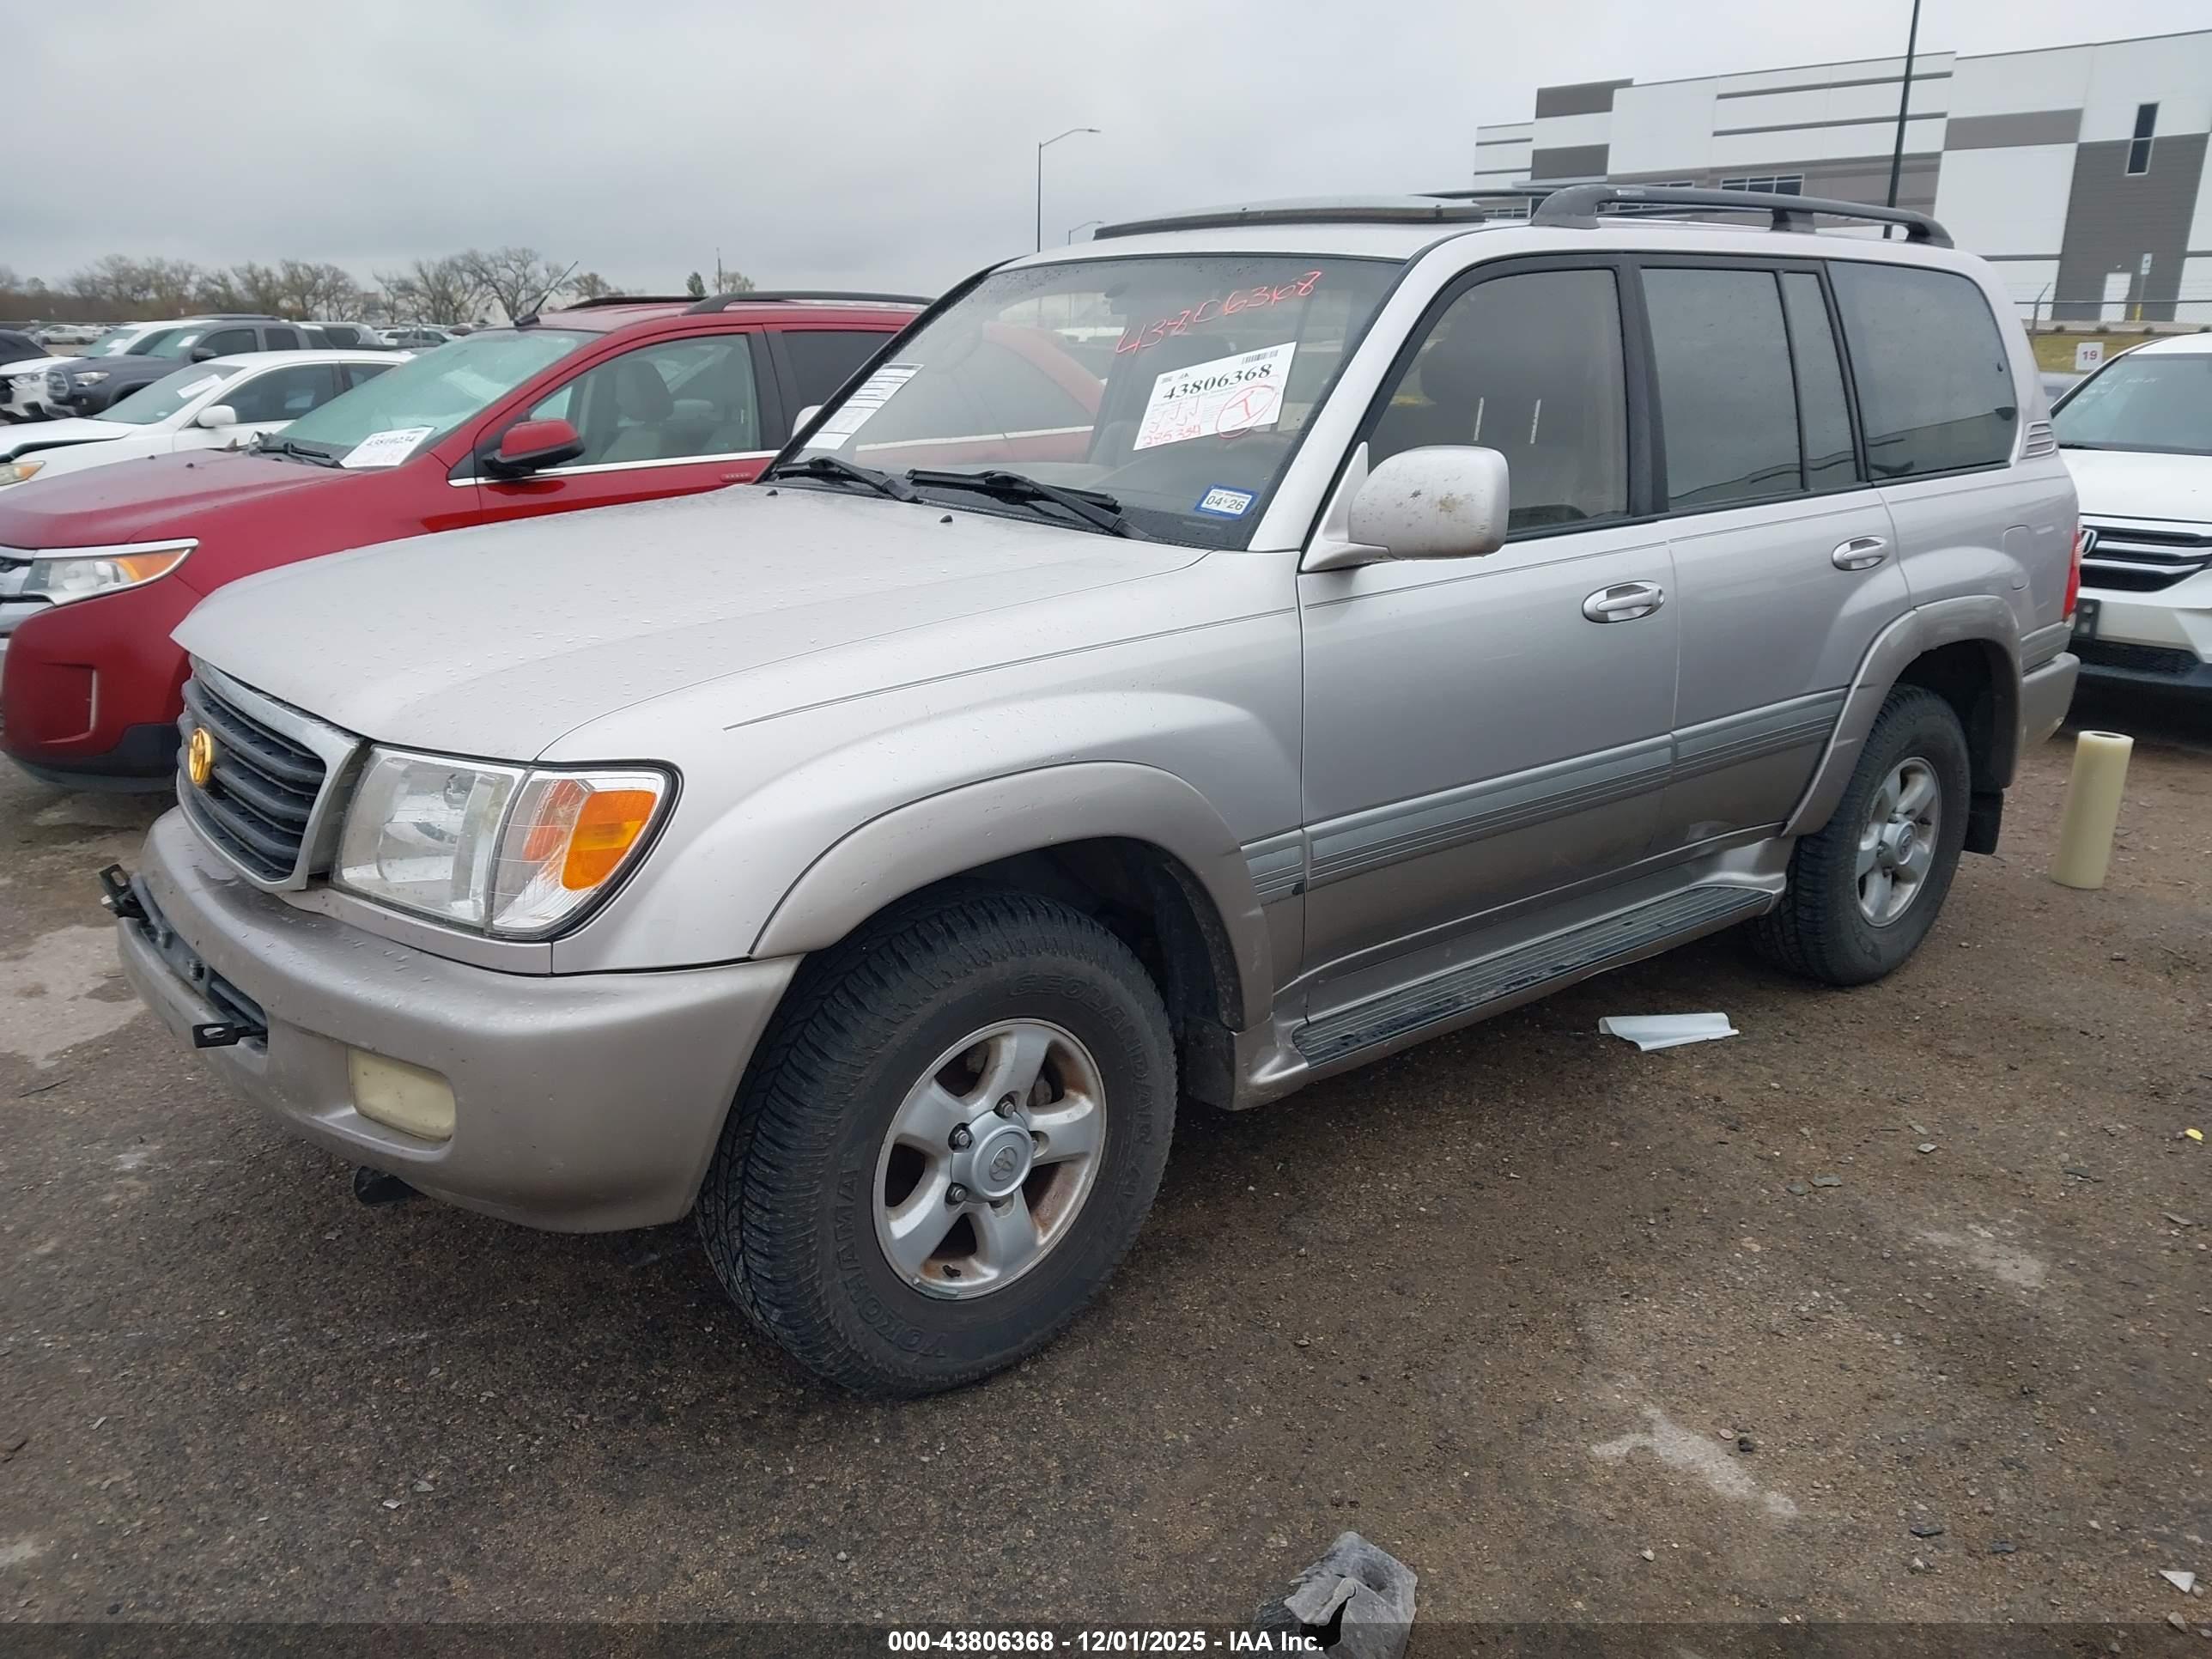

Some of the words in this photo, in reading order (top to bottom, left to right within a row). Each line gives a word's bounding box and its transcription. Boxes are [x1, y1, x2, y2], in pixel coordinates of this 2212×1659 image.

[2081, 349, 2098, 361] 19
[1163, 363, 1273, 400] 43806368
[1206, 495, 1224, 507] 04
[1225, 499, 1245, 511] 26
[834, 1167, 949, 1359] YOKOHAMA
